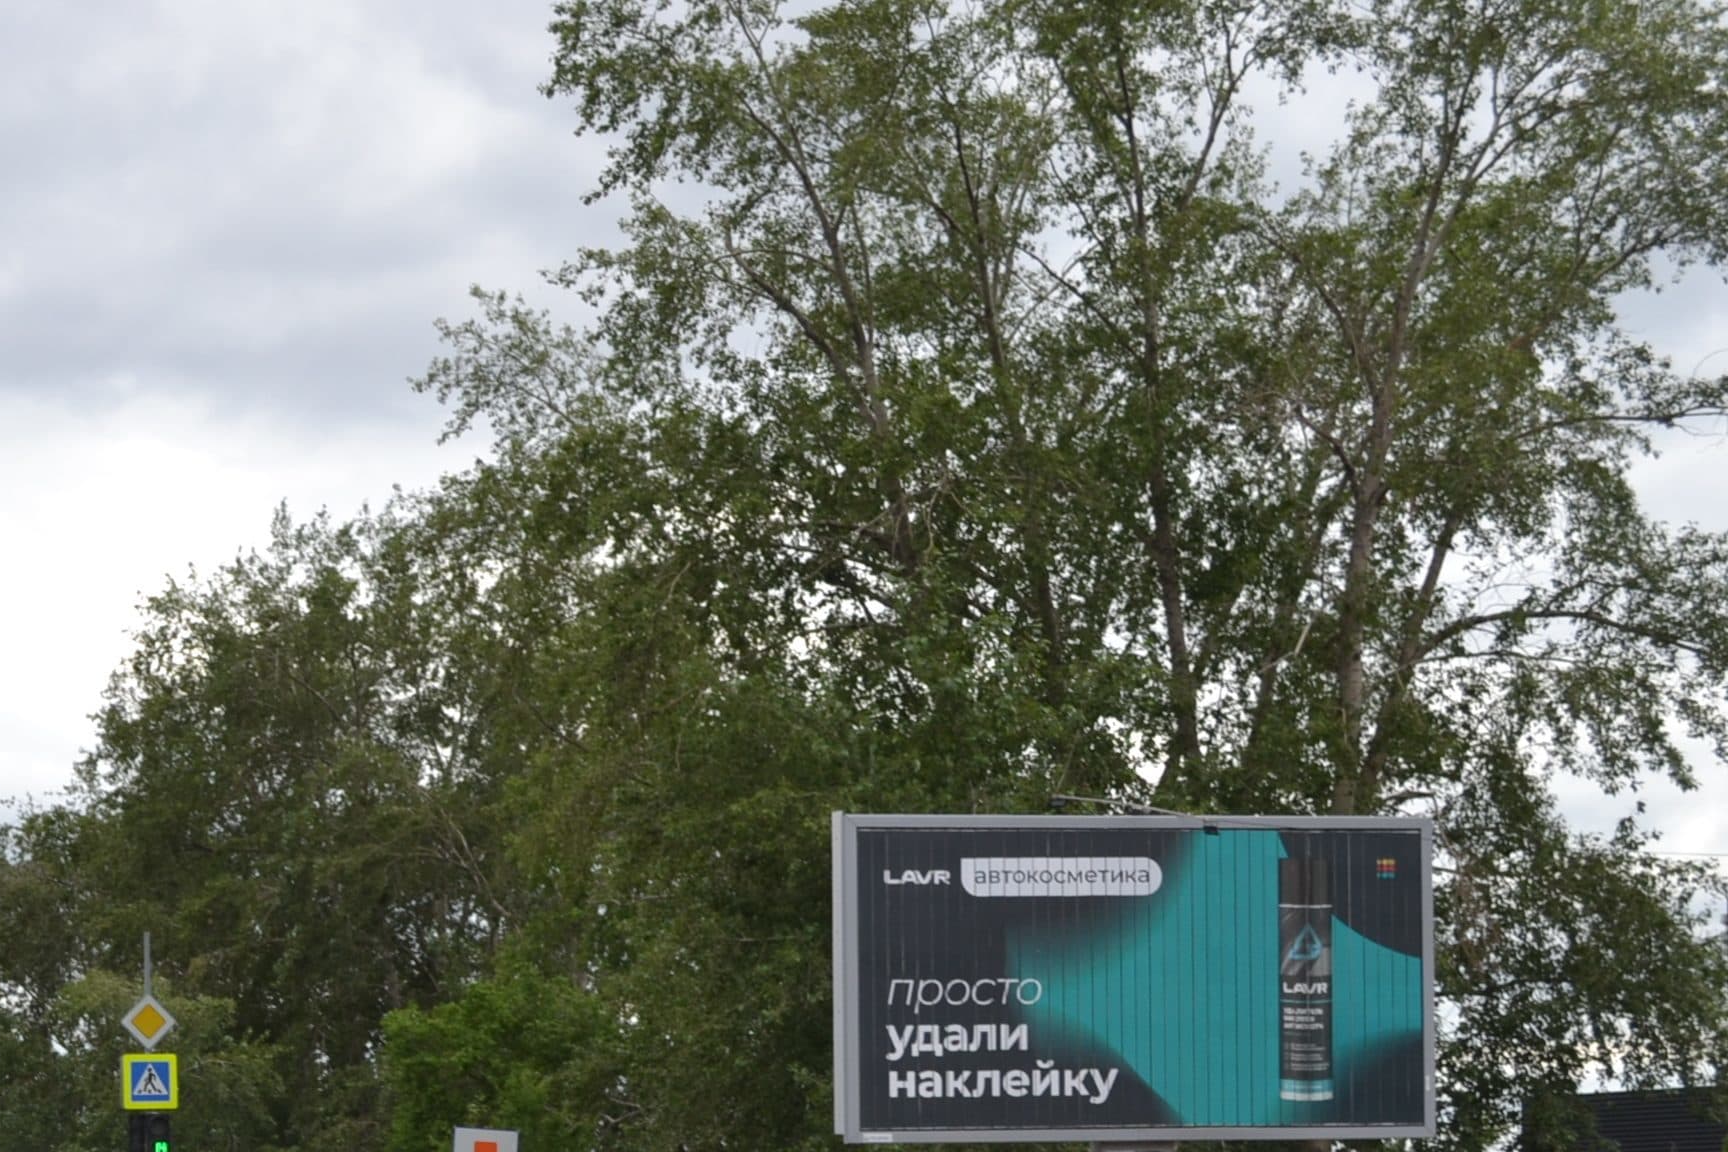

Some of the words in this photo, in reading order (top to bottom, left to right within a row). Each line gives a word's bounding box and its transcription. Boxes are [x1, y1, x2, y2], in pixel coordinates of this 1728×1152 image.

[883, 869, 951, 885] LAVR
[974, 868, 1151, 885] автокосметика
[887, 978, 1042, 1015] просто
[1282, 981, 1328, 995] LAVR
[885, 1023, 1029, 1061] удали
[888, 1059, 1119, 1105] наклейку
